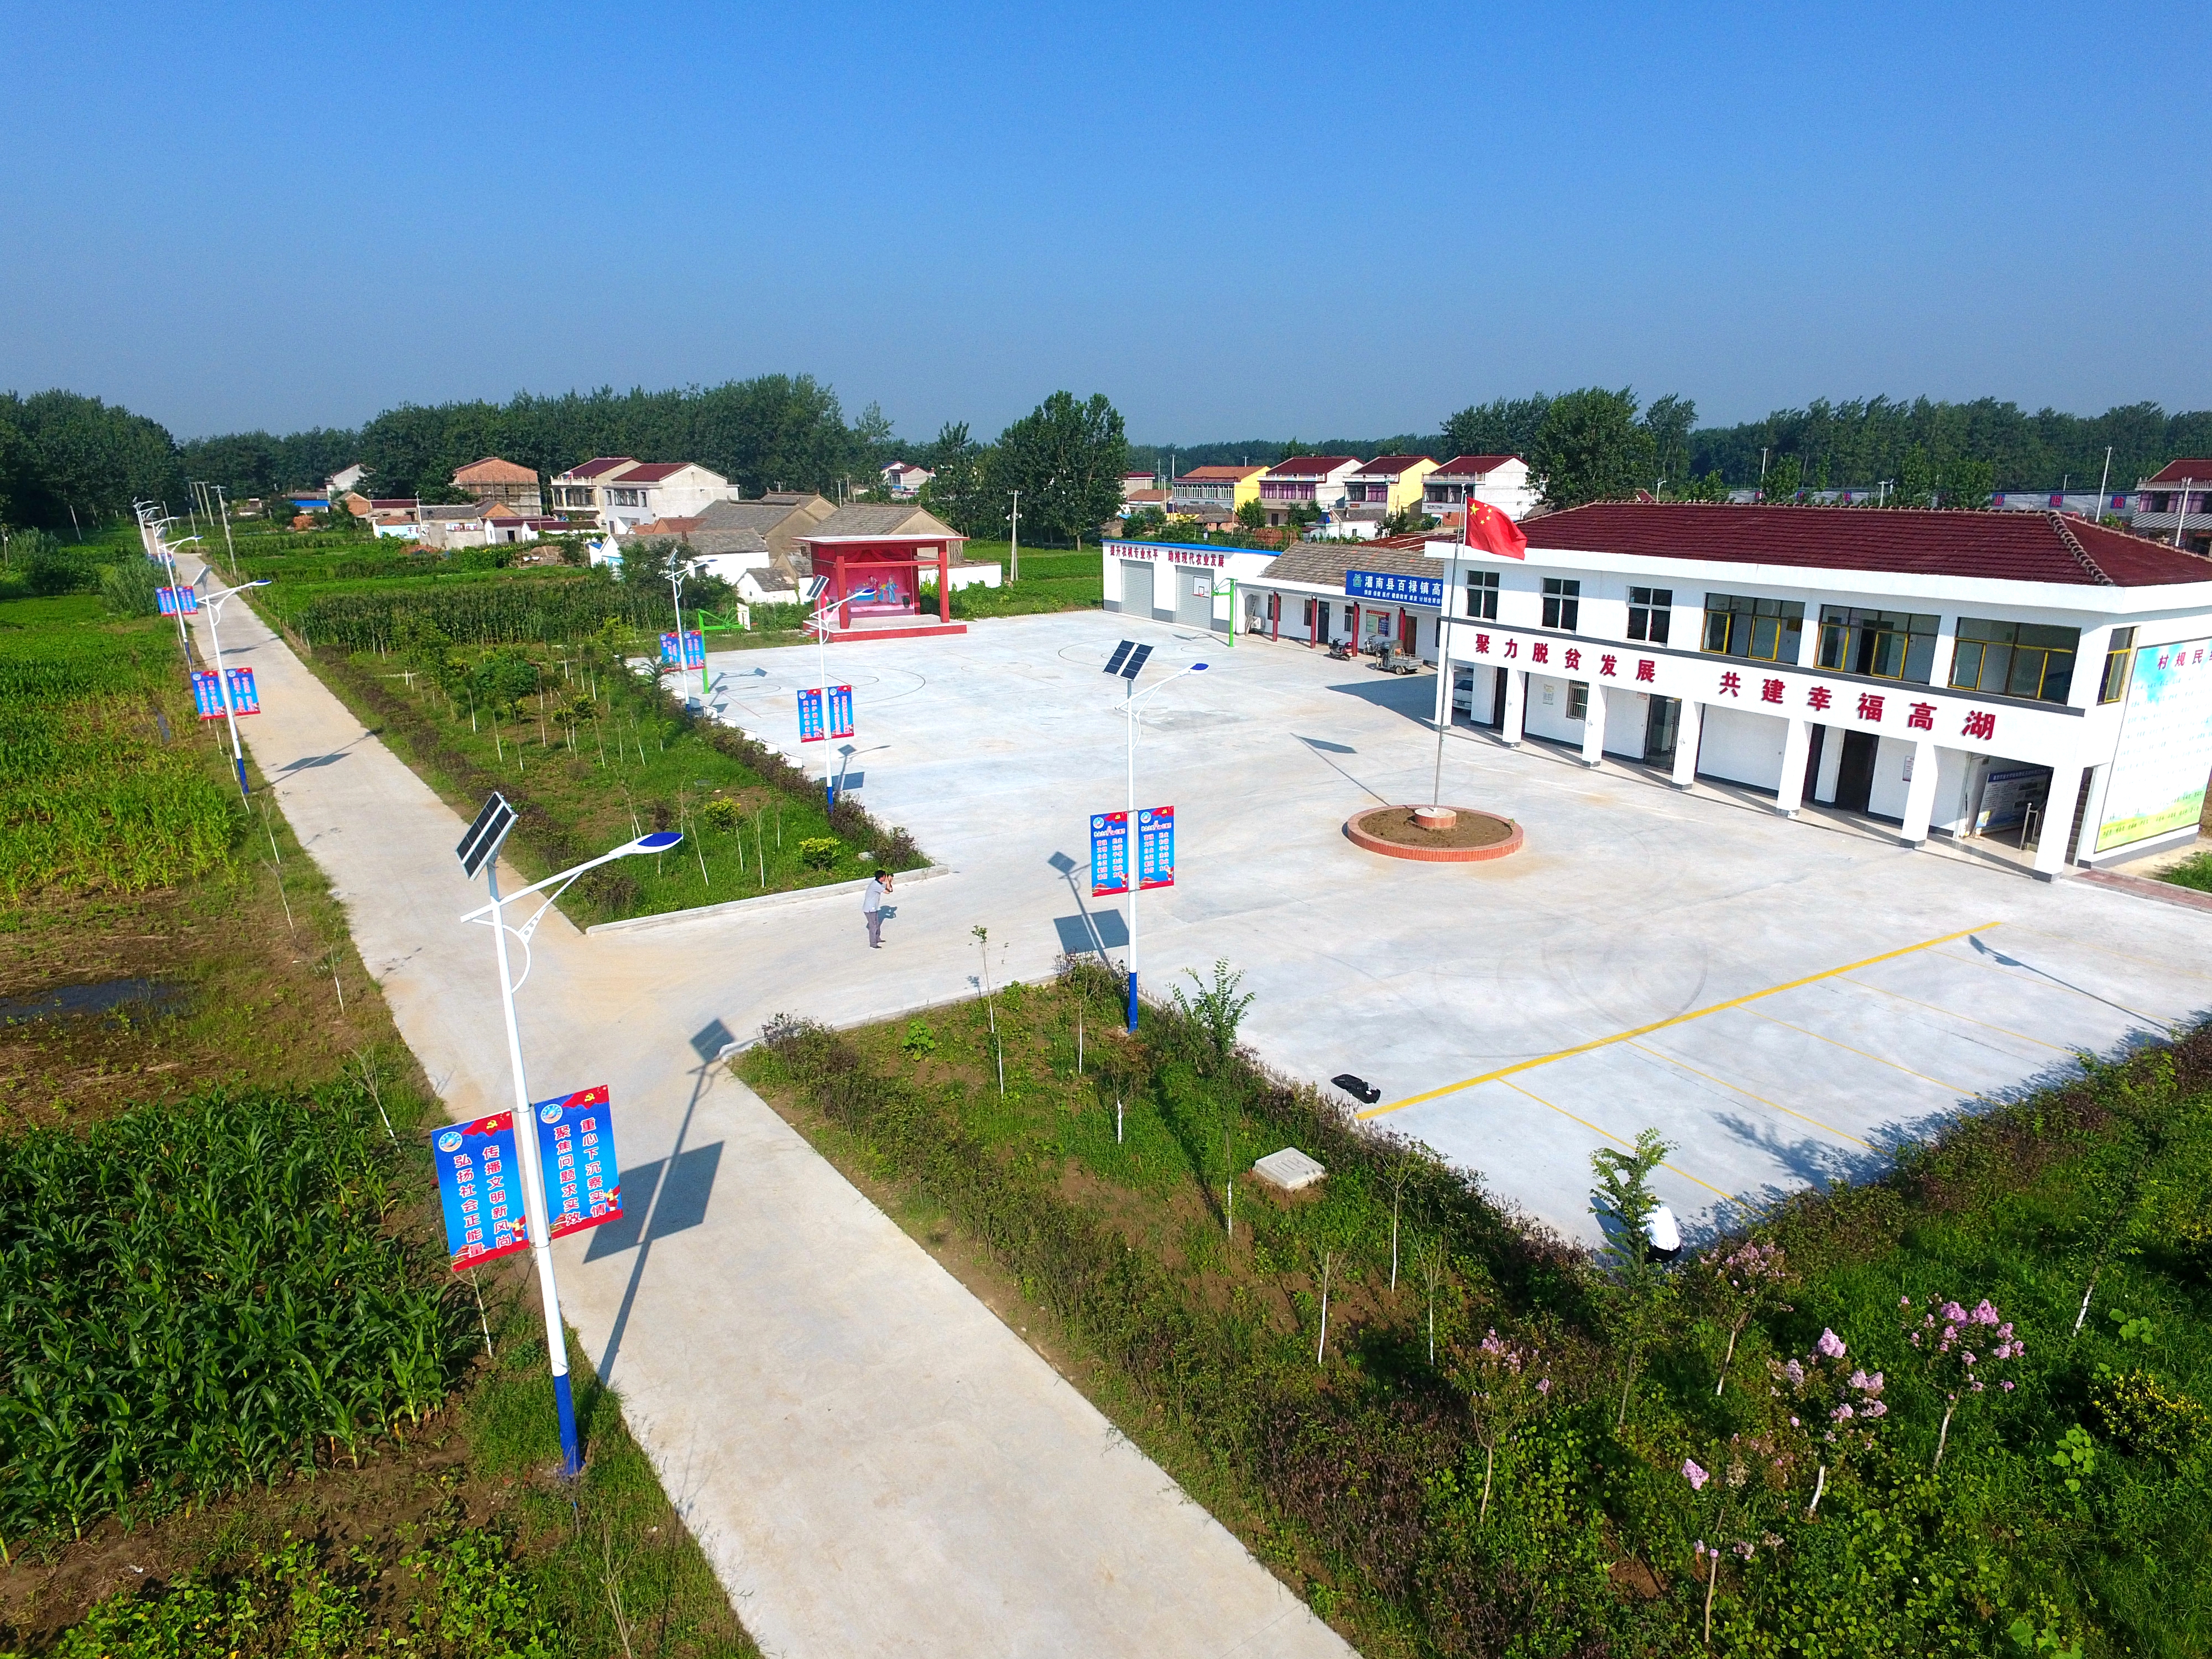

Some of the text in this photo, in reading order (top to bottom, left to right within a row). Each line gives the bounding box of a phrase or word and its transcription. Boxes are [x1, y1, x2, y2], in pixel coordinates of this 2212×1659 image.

[1110, 545, 1224, 568] 提升农机专业水平 助推现代农业发展
[1364, 576, 1441, 596] 灌南县百禄镇高
[1475, 633, 1996, 740] 聚力脱贫发展 共建幸福高湖
[2157, 648, 2212, 671] 村规民
[453, 1154, 485, 1258] 弘扬社会正能量
[482, 1145, 512, 1248] 传播文明新风尚
[554, 1125, 581, 1226] 聚焦问题求实效
[580, 1118, 606, 1218] 重心下沉察实情
